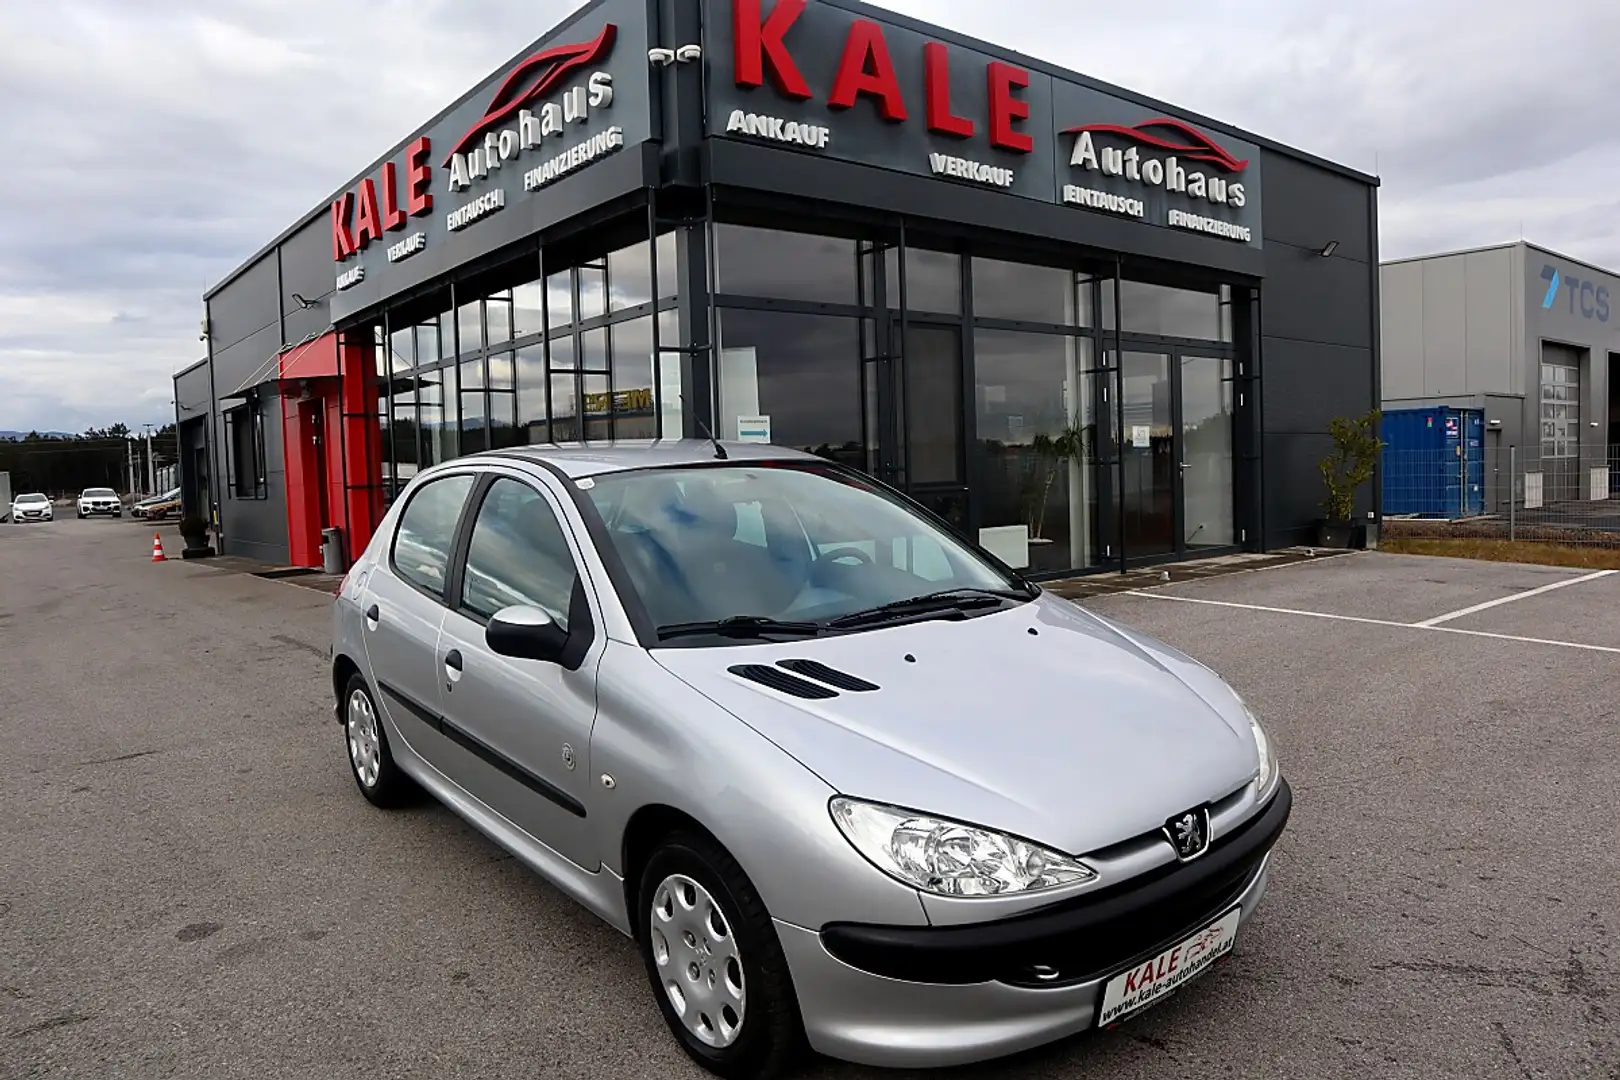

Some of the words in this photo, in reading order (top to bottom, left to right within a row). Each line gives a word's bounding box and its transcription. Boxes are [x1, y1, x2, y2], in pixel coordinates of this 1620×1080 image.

[733, 0, 1033, 153] KALE
[447, 189, 506, 232] EINTAUSCH
[524, 126, 624, 192] FINANZIERUNG
[448, 71, 613, 192] Autohaus
[726, 109, 830, 149] ANKAUF
[928, 152, 1014, 188] VERKAUF
[1063, 184, 1144, 218] EINTAUSCH
[1168, 209, 1251, 242] FINANZIERUNG
[1070, 131, 1246, 208] Autohaus
[331, 136, 434, 262] KALE
[1564, 275, 1610, 323] TCS
[1102, 936, 1233, 1022] www.kale-autohandel.at
[1123, 946, 1182, 997] KALE
